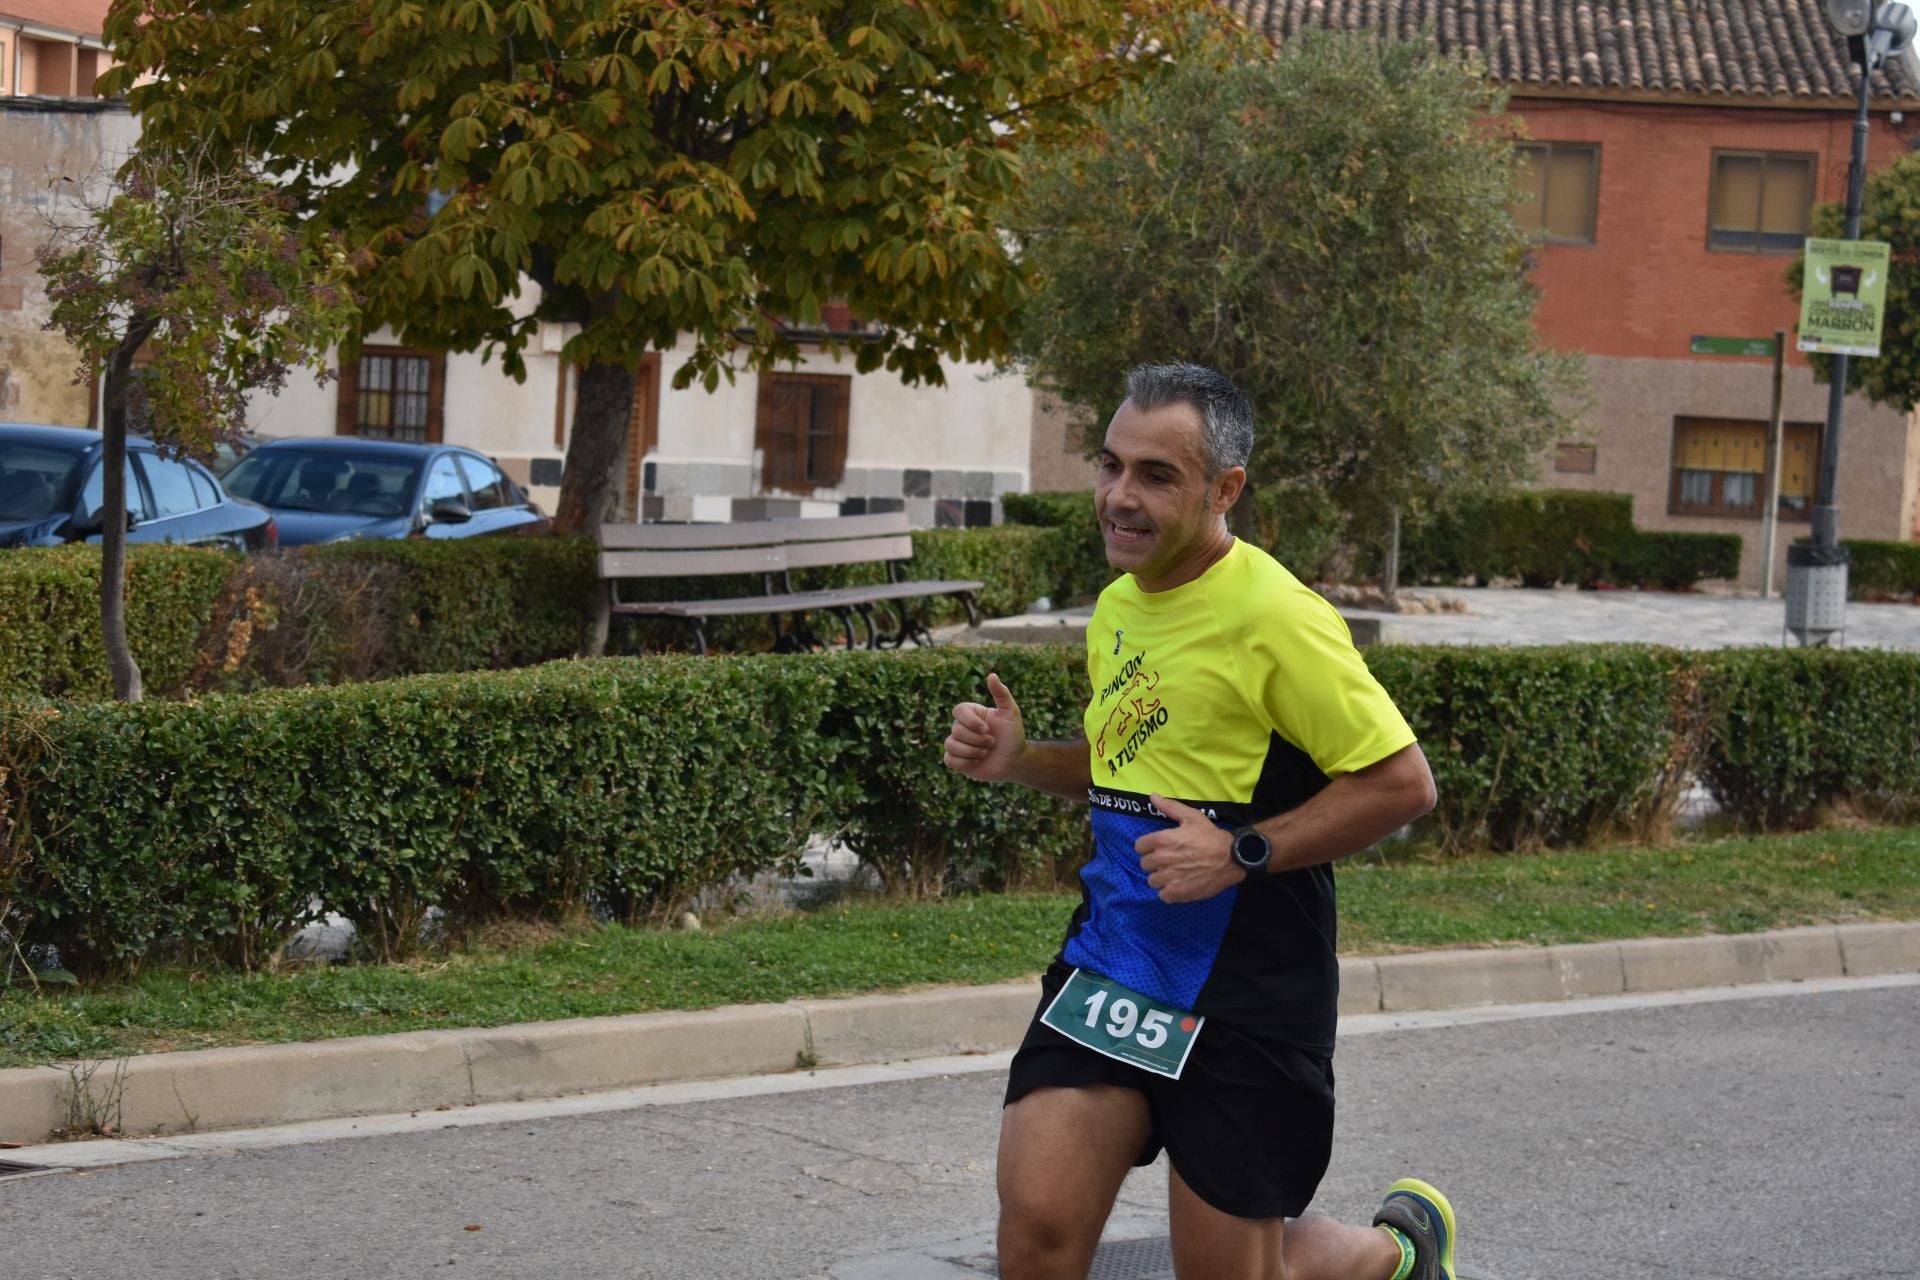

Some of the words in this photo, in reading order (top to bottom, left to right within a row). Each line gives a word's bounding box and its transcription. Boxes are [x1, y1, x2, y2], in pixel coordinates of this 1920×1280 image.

[1107, 706, 1168, 777] ATLETISMO
[1099, 794, 1112, 807] DE
[1084, 990, 1174, 1049] 195
